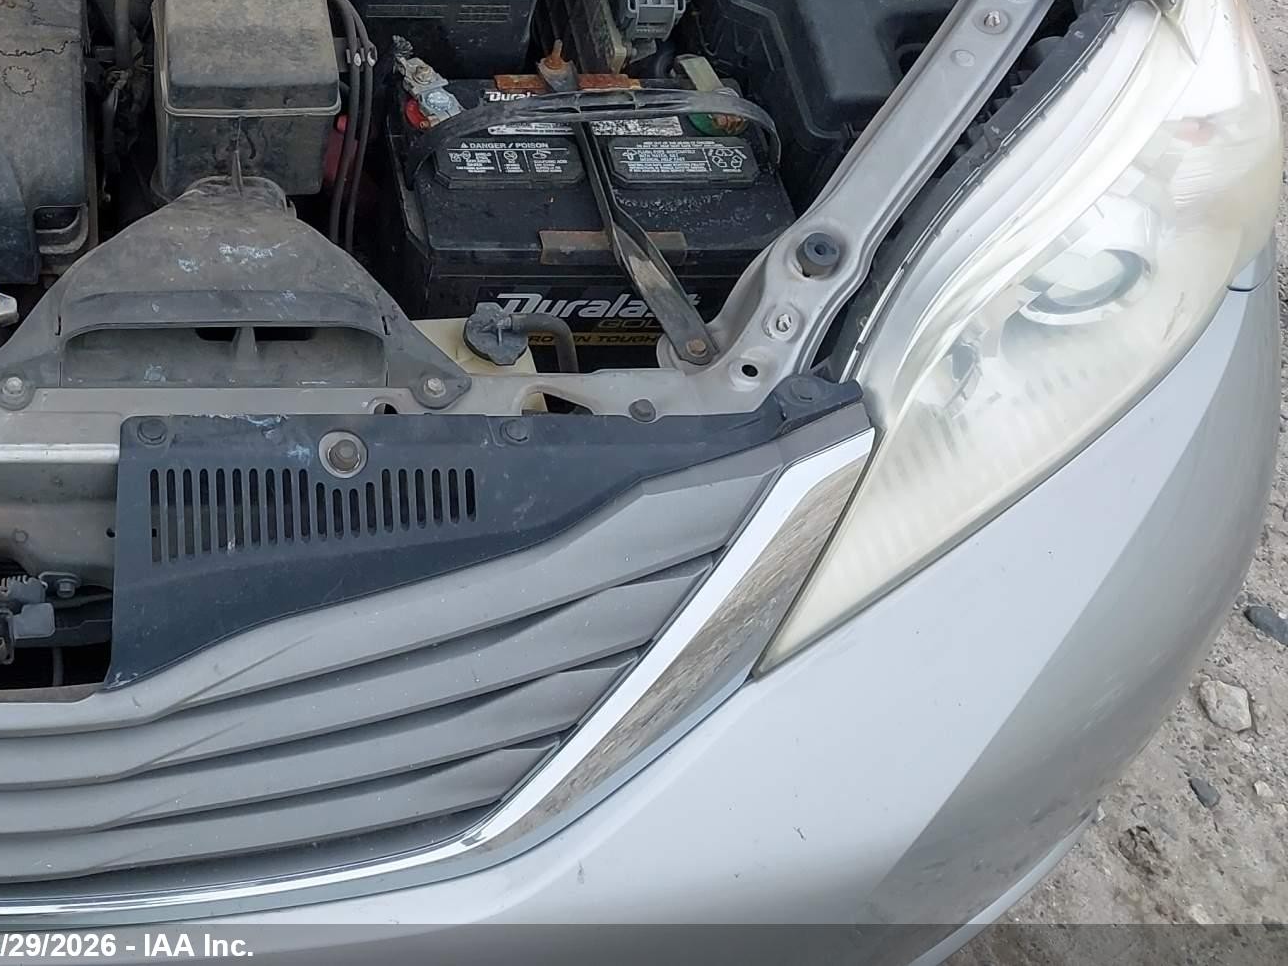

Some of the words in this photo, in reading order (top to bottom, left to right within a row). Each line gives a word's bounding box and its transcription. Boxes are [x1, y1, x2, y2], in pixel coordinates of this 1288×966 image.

[496, 293, 701, 318] Durala
[597, 318, 662, 329] GOL
[528, 335, 592, 343] RON
[599, 335, 657, 343] TOUGH
